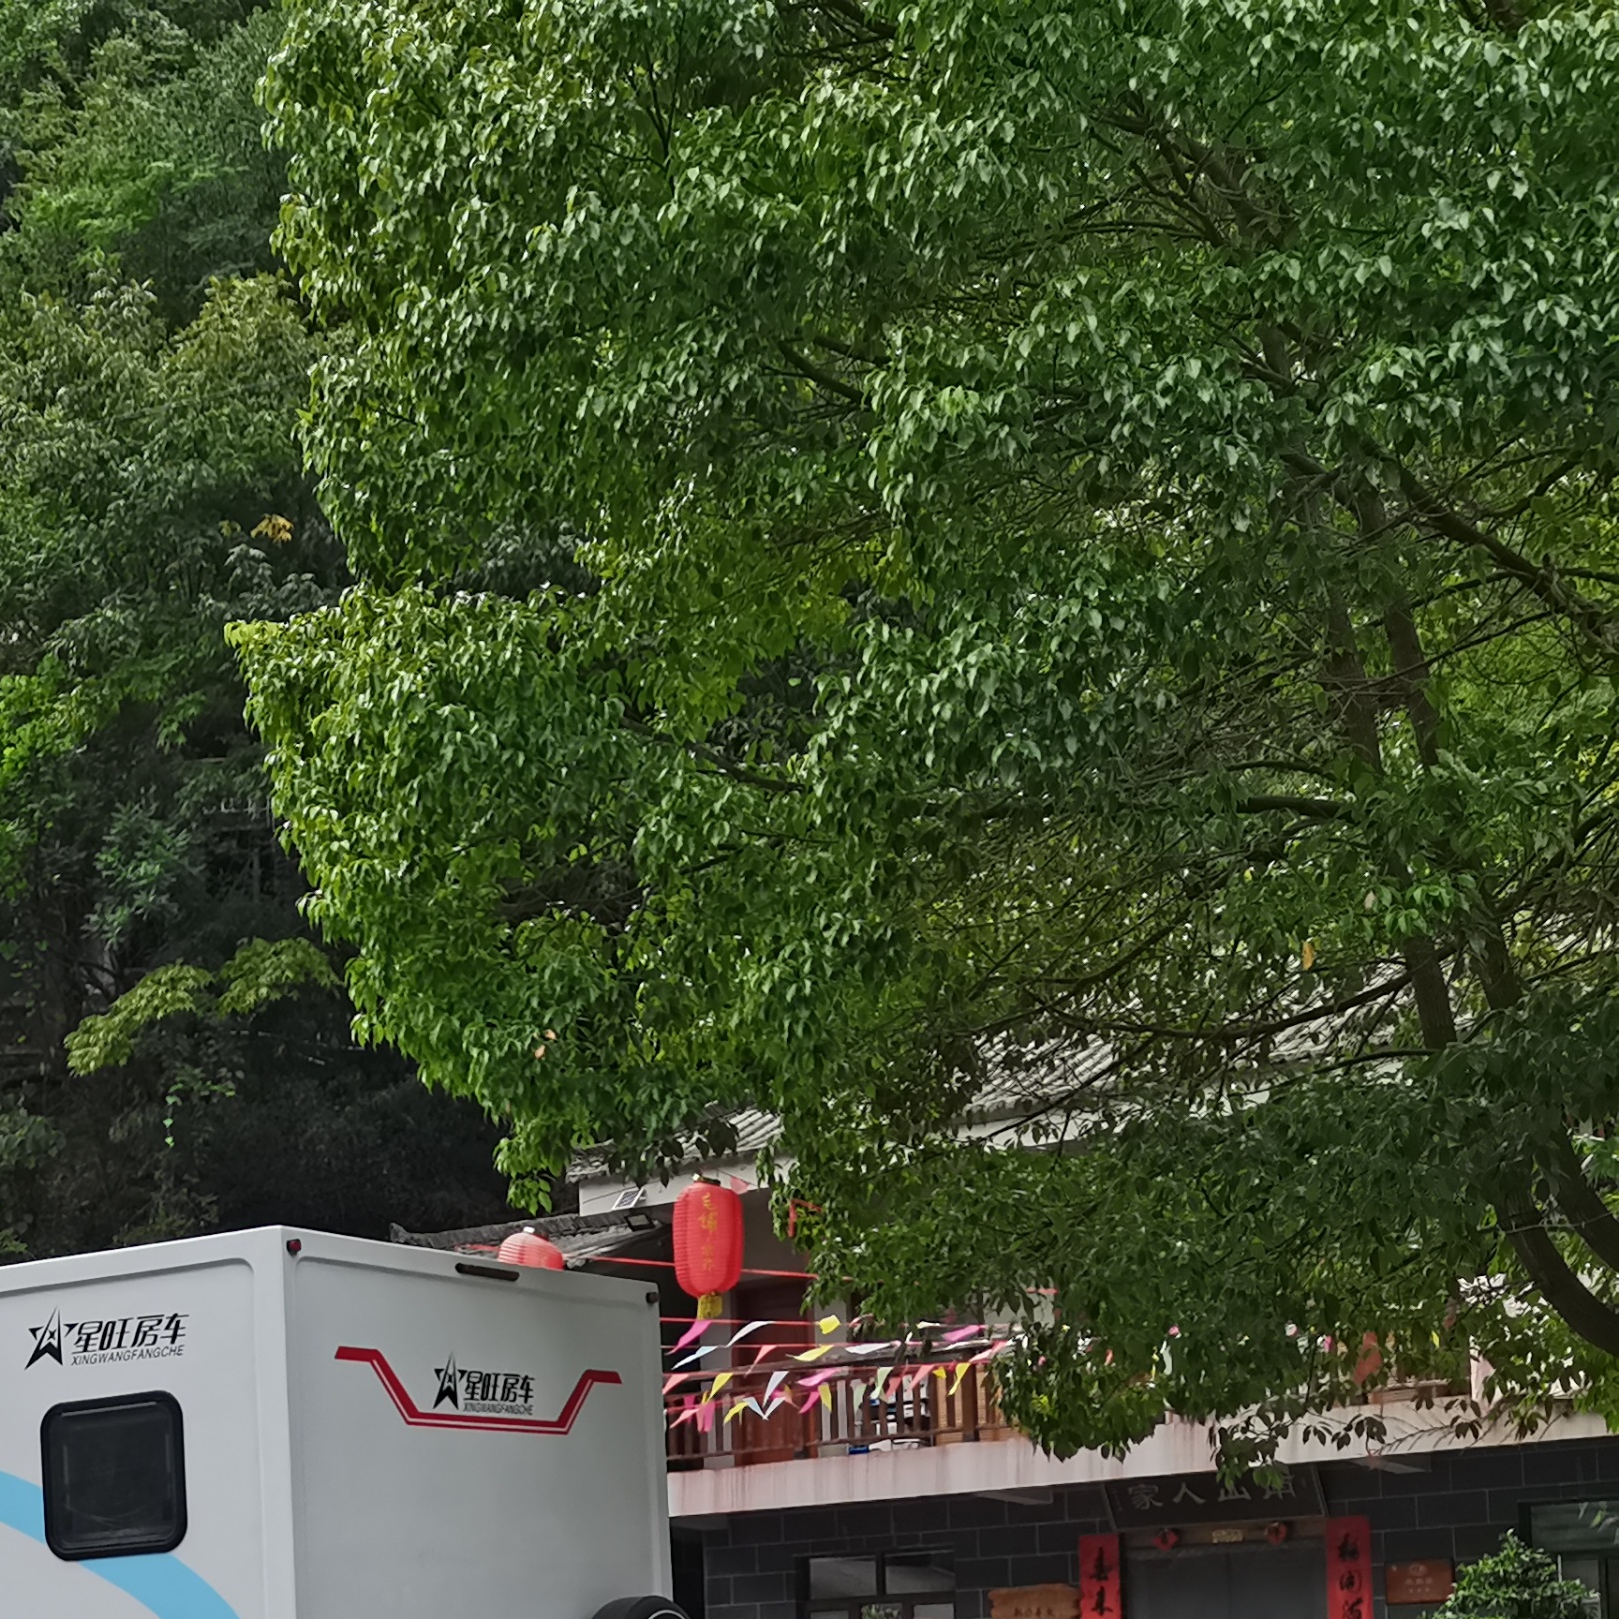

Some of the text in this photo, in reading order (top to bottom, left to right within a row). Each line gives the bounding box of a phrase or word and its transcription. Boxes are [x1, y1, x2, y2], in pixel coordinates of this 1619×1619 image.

[71, 1312, 190, 1355] 星旺房车
[71, 1344, 185, 1366] XINGWANGFANGCHE
[463, 1370, 535, 1404] 星旺房车
